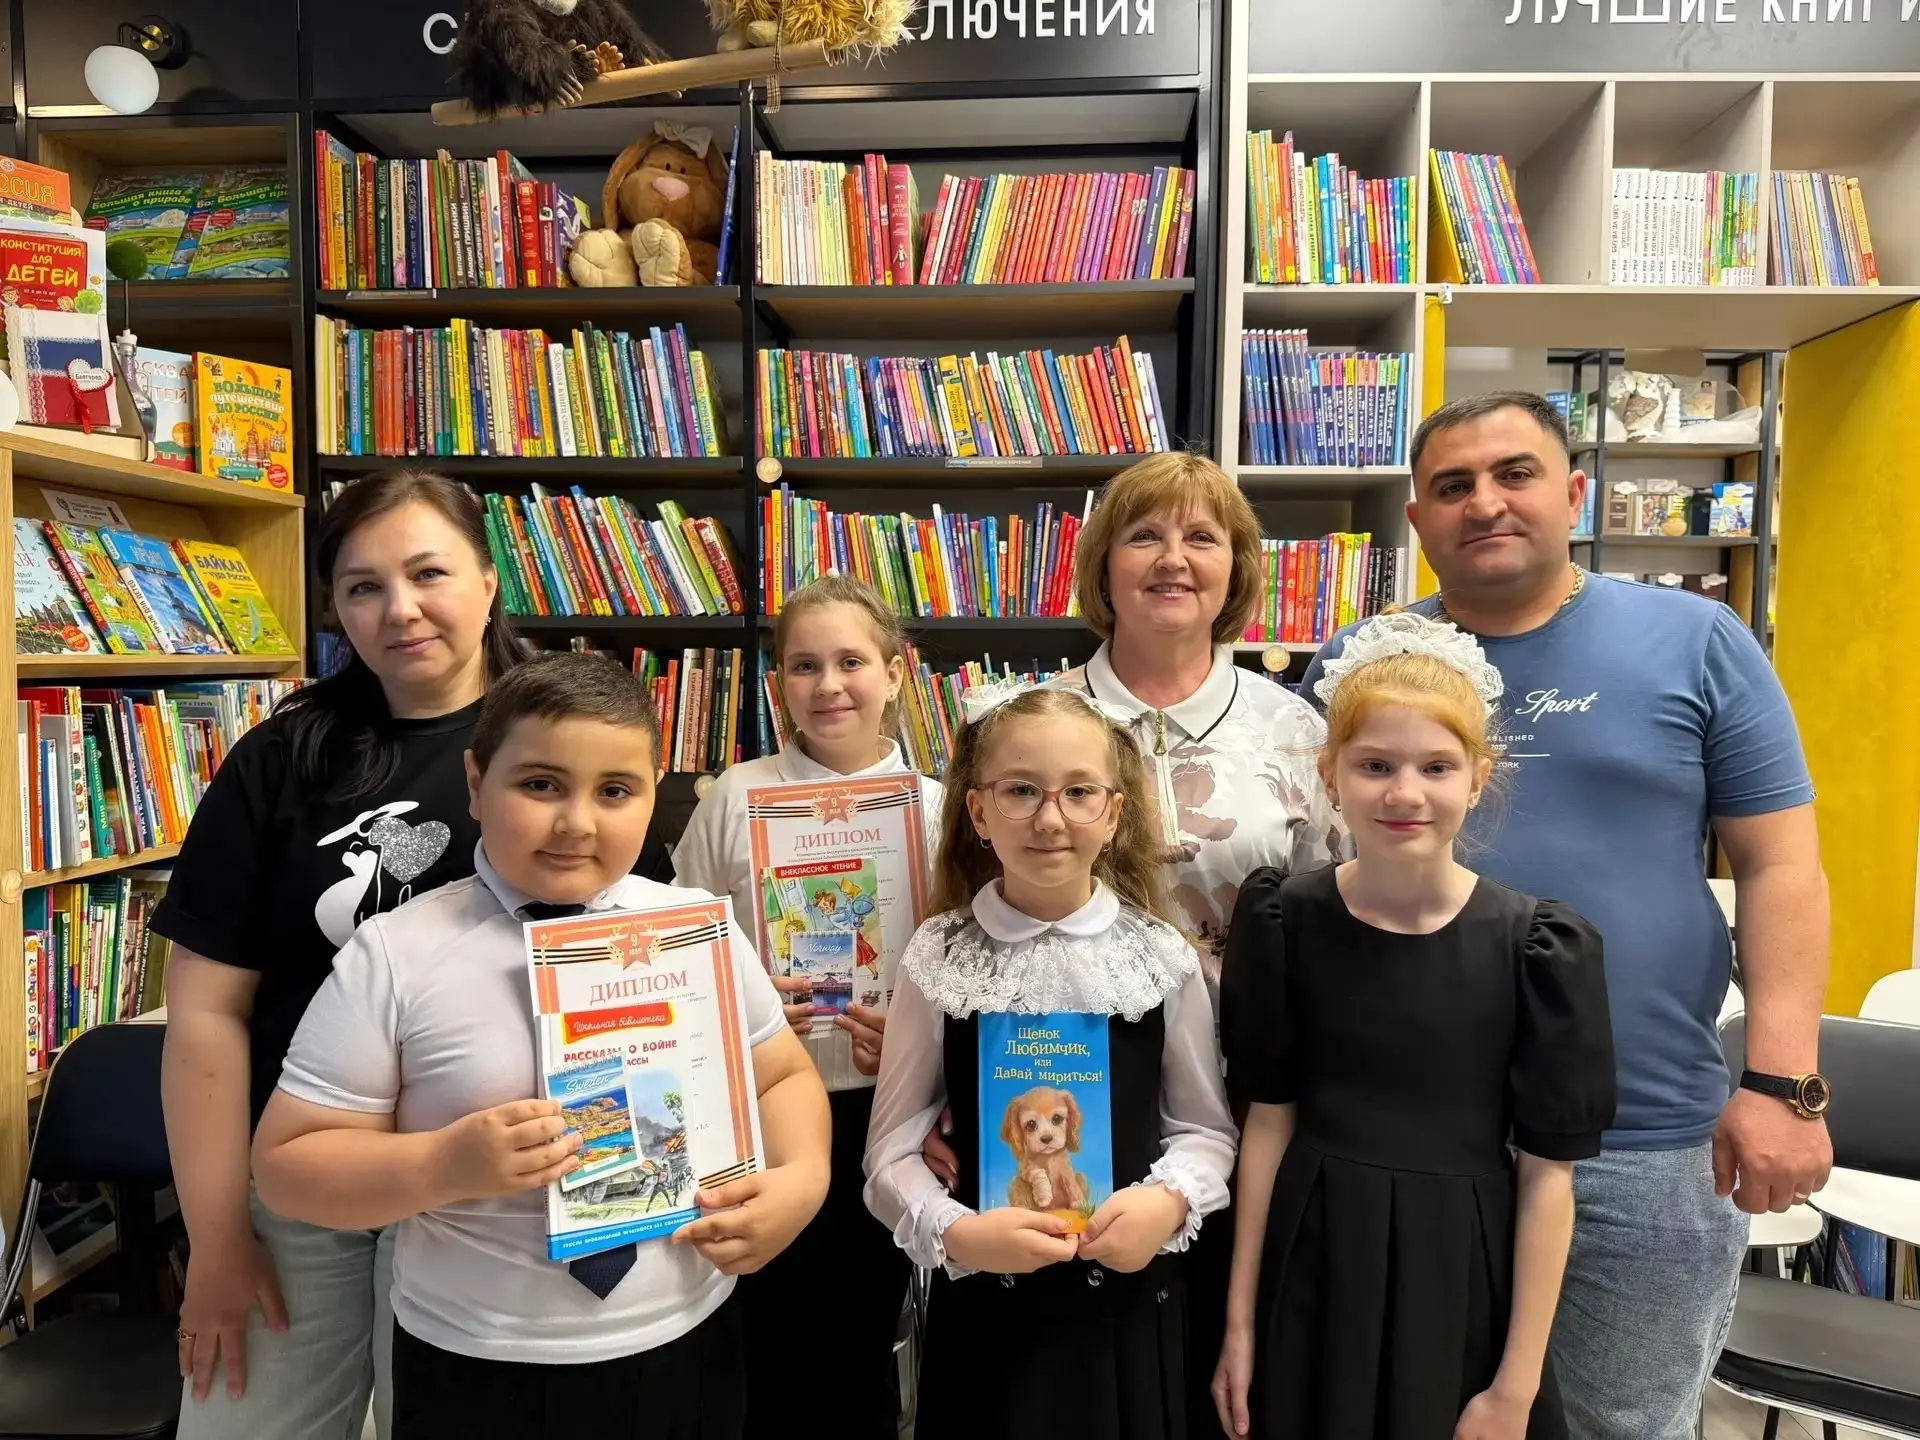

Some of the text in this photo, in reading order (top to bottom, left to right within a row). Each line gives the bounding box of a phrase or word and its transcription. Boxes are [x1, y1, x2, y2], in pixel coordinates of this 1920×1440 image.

[92, 188, 182, 210] Большая книга
[142, 195, 192, 206] природе
[217, 186, 270, 203] Большая
[462, 202, 471, 245] ПРИШВИН
[0, 238, 82, 257] КОНСТИТУЦИЯ
[451, 202, 462, 275] Виталий БИАНКИ
[30, 254, 53, 265] ДЛЯ
[6, 263, 79, 288] ДЕТЕЙ
[209, 393, 285, 413] путешествие
[216, 403, 233, 415] ПО
[948, 390, 961, 423] ИСТОРИИ
[194, 554, 248, 574] БАЙКАЛ
[555, 536, 585, 602] Алексей ТОЛСТОЙ
[1514, 688, 1599, 723] Sport
[1497, 761, 1520, 769] YORK
[831, 798, 838, 807] 9
[794, 827, 882, 852] ДИПЛОМ
[780, 861, 857, 877] ВНЕКЛАССНОЕ ЧТЕНИЕ
[631, 934, 638, 946] 9
[806, 940, 843, 954] Norway
[590, 970, 688, 1006] ДИПЛОМ
[573, 1014, 666, 1033] Школьная библиотека
[1018, 1027, 1060, 1041] Щенок
[628, 1044, 637, 1054] О
[643, 1039, 677, 1052] ВОЙНЕ
[1005, 1040, 1091, 1057] Любимчик,
[1034, 1058, 1052, 1067] или
[566, 1073, 609, 1095] Sweden
[994, 1067, 1103, 1085] Давай мириться!
